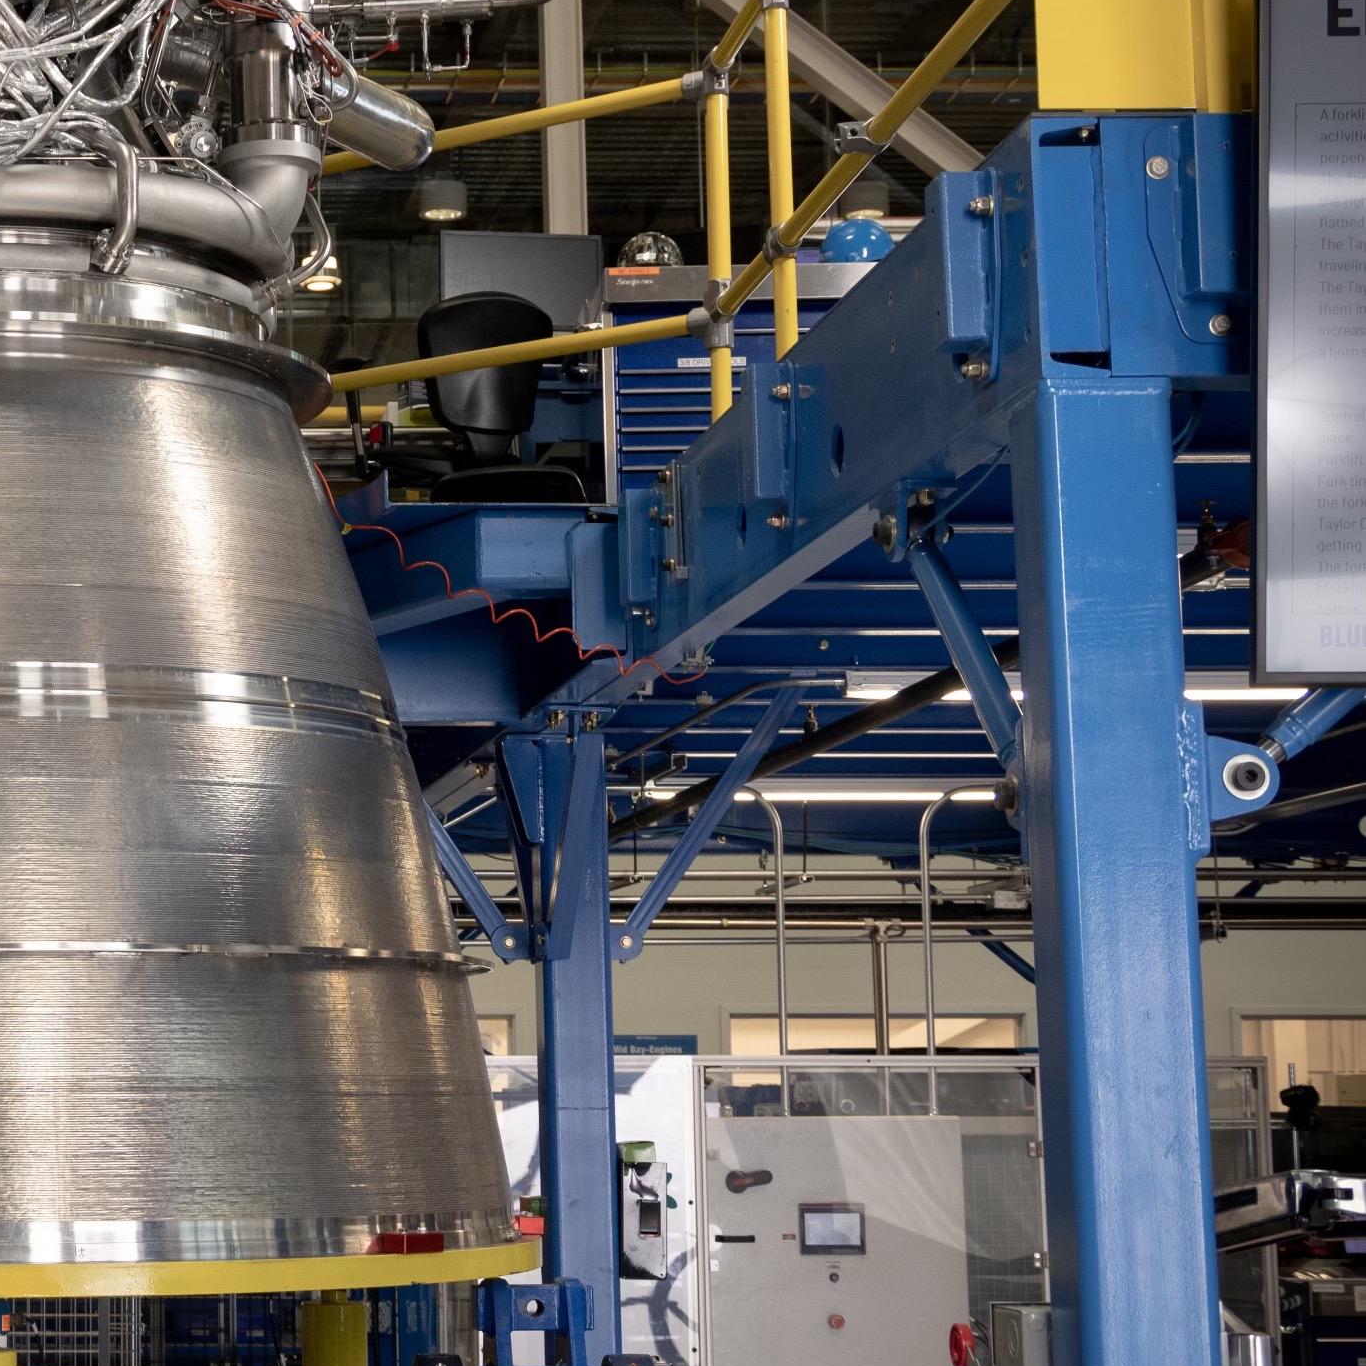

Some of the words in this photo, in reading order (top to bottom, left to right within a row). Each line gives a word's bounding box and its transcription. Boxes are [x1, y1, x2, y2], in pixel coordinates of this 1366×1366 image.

[1320, 108, 1329, 121] A
[1320, 216, 1365, 230] flatbed
[1321, 238, 1344, 251] The
[1320, 281, 1343, 294] The
[1319, 302, 1352, 315] them
[692, 358, 712, 366] DRIV
[1317, 496, 1339, 508] the
[1319, 517, 1355, 532] Taylor
[1316, 538, 1362, 554] getting
[1318, 560, 1341, 573] The
